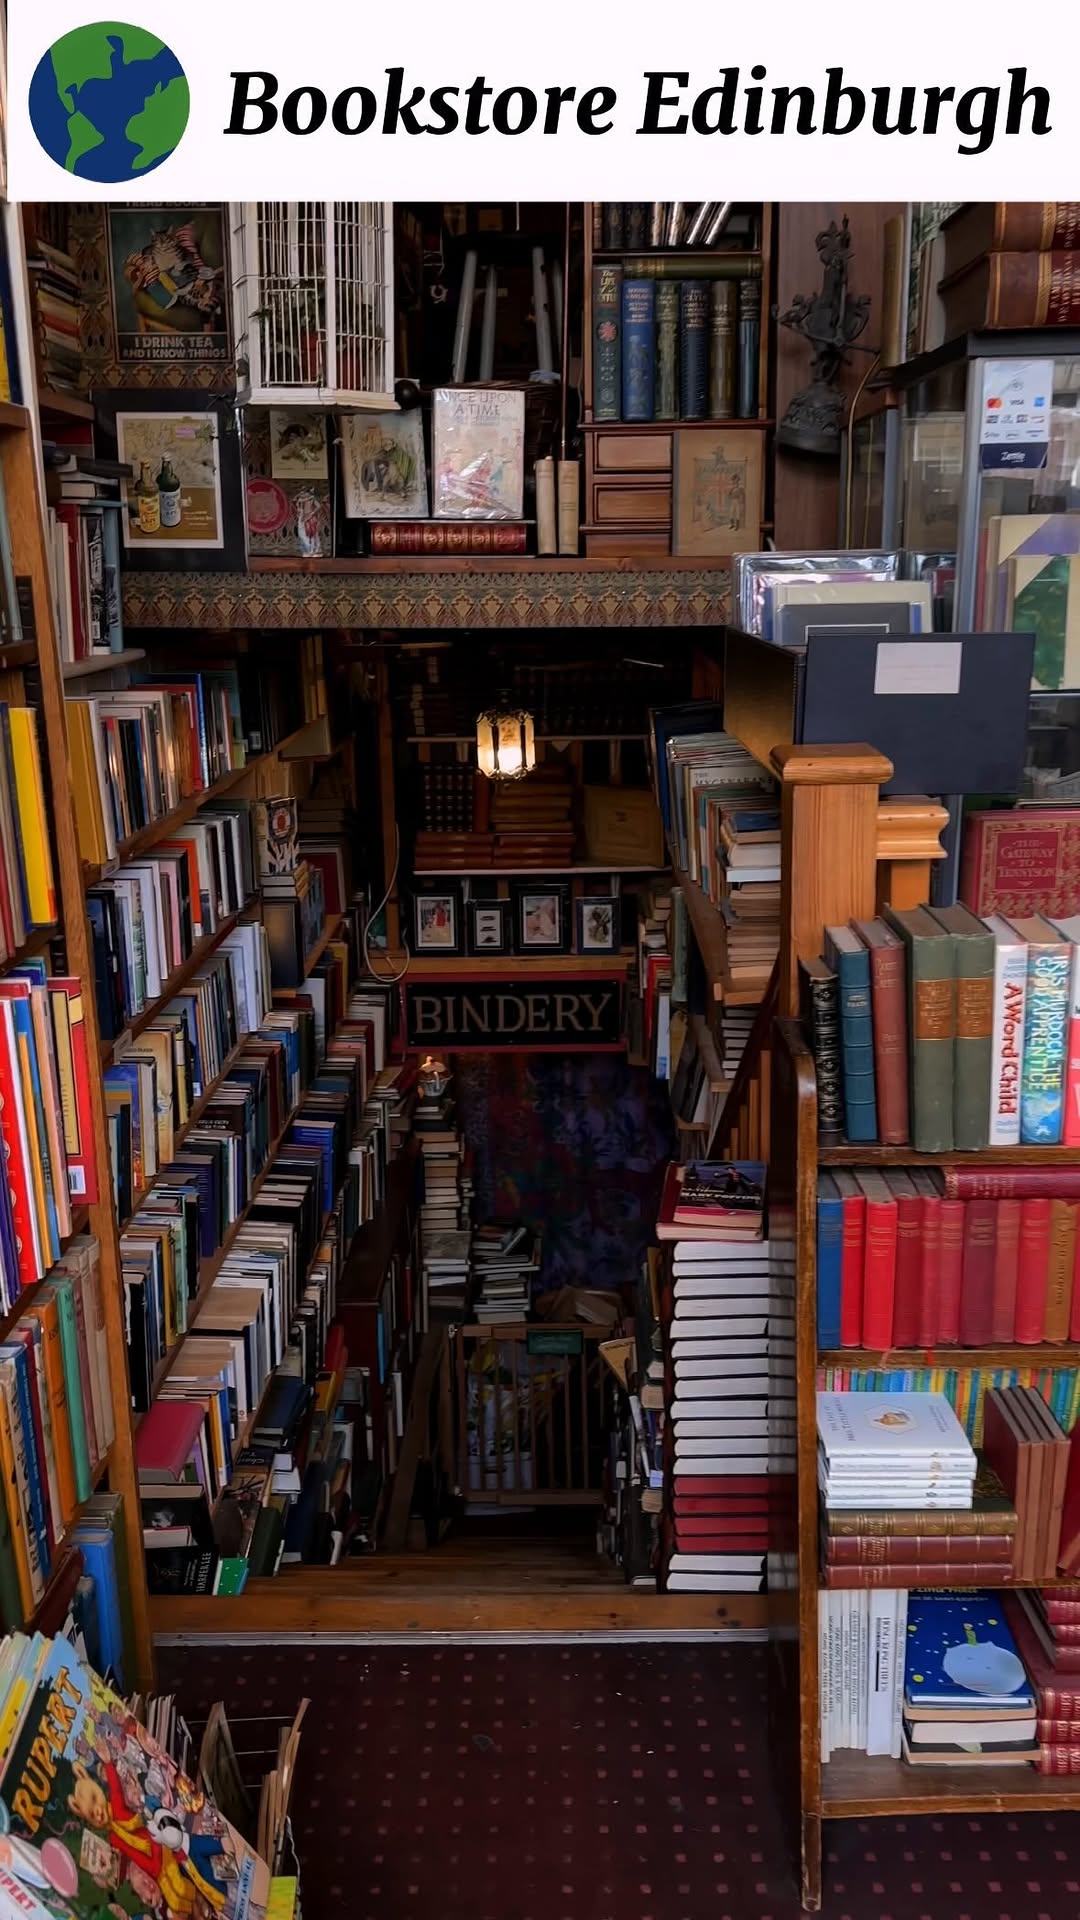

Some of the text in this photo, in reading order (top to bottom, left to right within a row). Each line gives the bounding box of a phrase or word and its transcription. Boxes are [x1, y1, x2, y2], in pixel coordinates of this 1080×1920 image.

[123, 348, 226, 358] AND I KNOW THINGS
[135, 336, 214, 348] I DRINK TEA
[454, 403, 501, 417] A TIME
[480, 391, 517, 404] UPON
[996, 866, 1057, 878] TENNYSON
[1019, 859, 1036, 868] TO
[1050, 955, 1070, 987] IRIS
[1004, 982, 1024, 1001] A
[411, 993, 613, 1034] BINDERY
[1001, 1000, 1023, 1059] Word
[1046, 990, 1068, 1060] MURDOCH
[1027, 998, 1050, 1090] APPRENTICE
[998, 1060, 1019, 1115] Child
[195, 1551, 212, 1593] HARPER LEE
[12, 1665, 82, 1833] RUPERT
